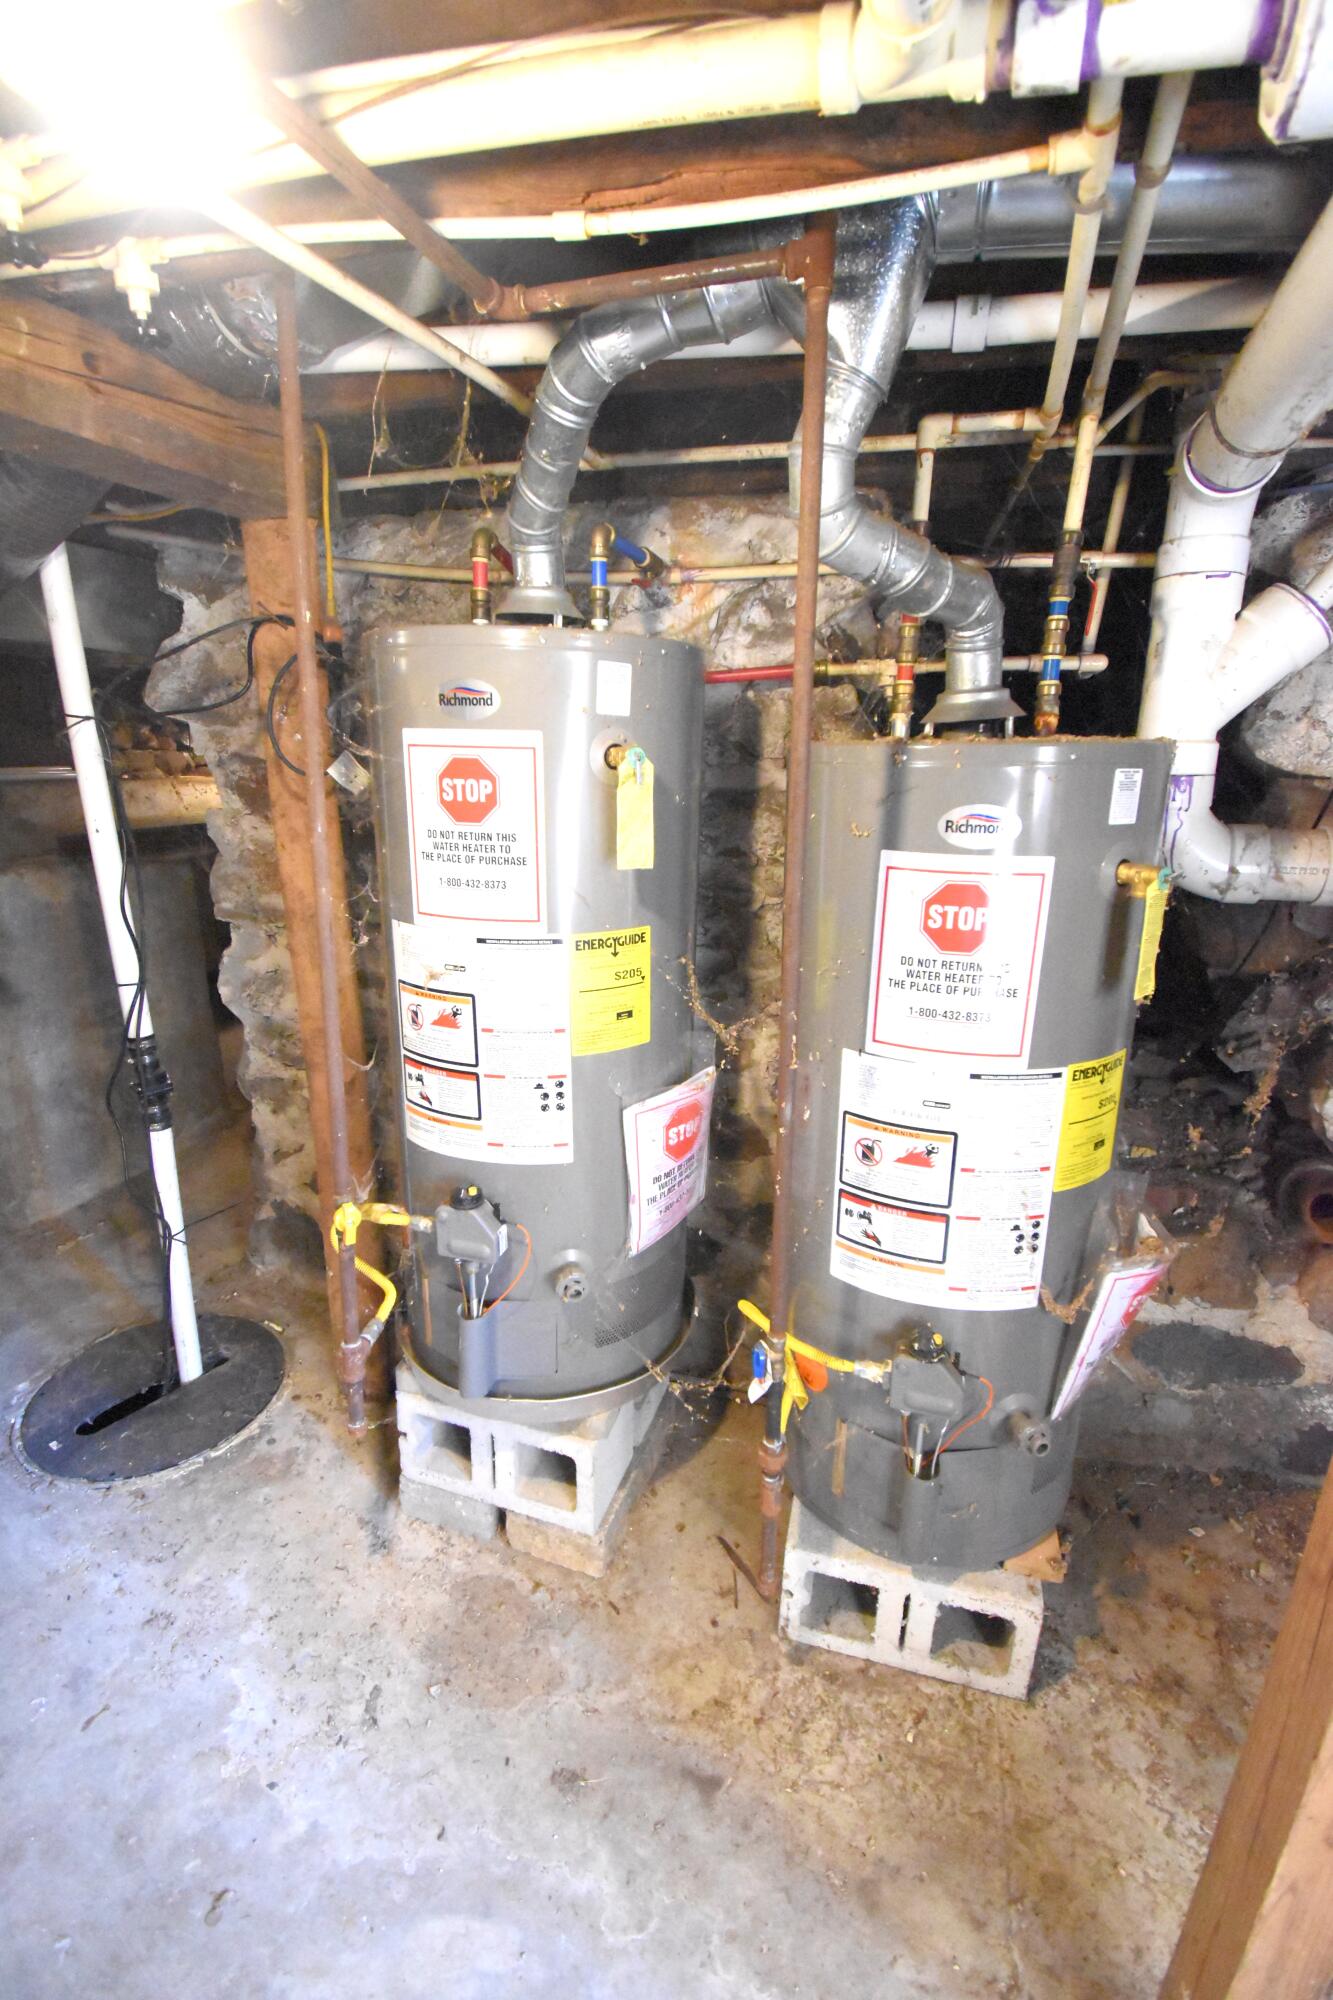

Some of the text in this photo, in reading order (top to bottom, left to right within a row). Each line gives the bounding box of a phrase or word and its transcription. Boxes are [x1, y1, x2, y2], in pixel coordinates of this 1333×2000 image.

[438, 691, 493, 706] Richmond
[442, 777, 493, 803] STOP
[427, 829, 517, 842] DO NOT RETURN THIS
[432, 841, 511, 854] WATER HEATER TO
[421, 851, 528, 866] THE PLACE OF PURCHASE
[439, 877, 507, 890] 1-800-432-8373
[927, 904, 989, 931] STOP
[575, 931, 646, 953] ENERGYGUIDE
[900, 955, 914, 967] DO
[917, 957, 938, 969] NOT
[940, 960, 983, 973] RETURN
[906, 968, 941, 982] WATER
[888, 977, 906, 990] THE
[909, 981, 942, 994] PLACE
[945, 985, 960, 996] OF
[882, 1126, 921, 1139] WARNING
[652, 1174, 662, 1185] DO
[646, 1194, 658, 1207] THE
